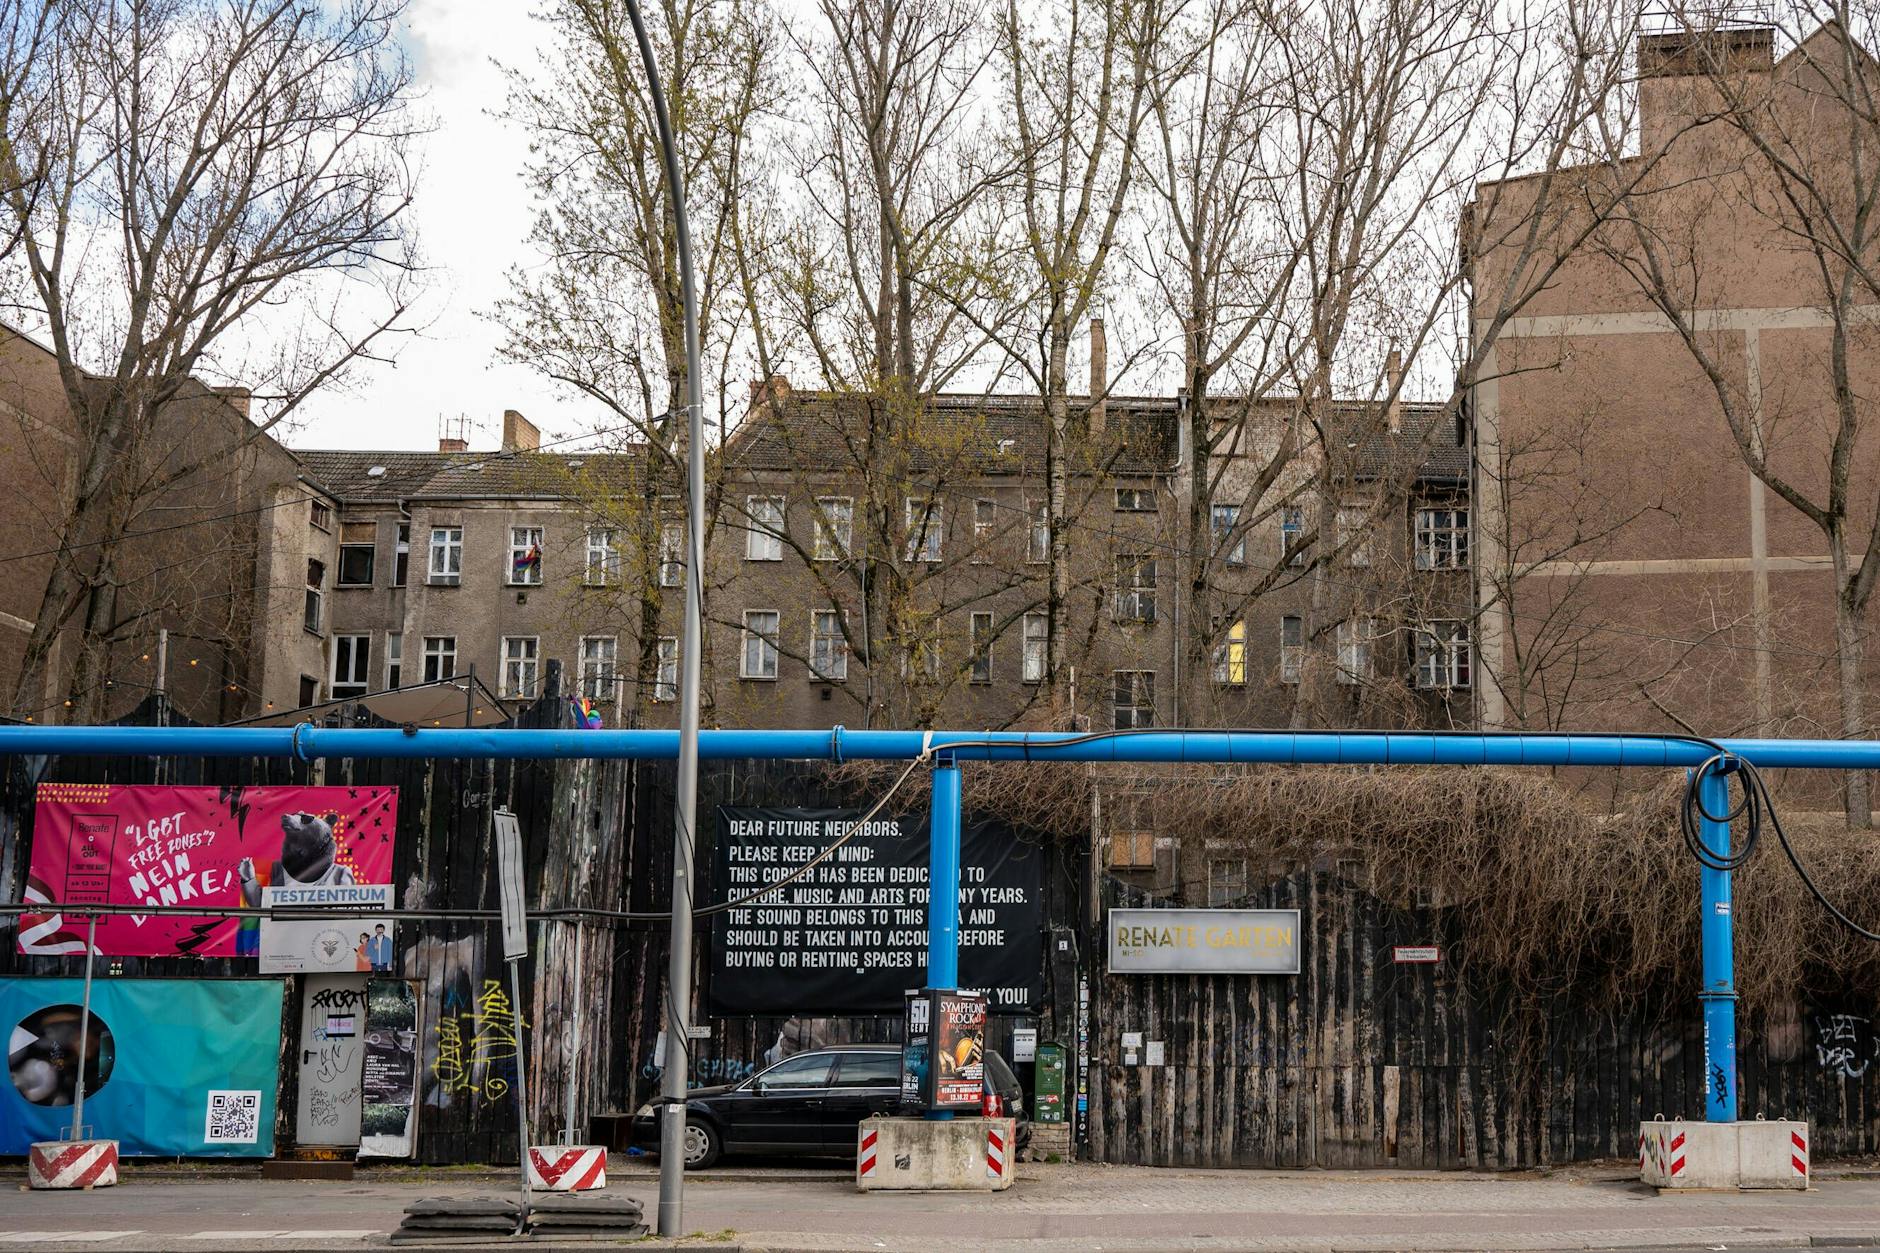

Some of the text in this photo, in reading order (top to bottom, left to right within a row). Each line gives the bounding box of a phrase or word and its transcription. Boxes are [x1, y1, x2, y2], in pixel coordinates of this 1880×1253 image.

[730, 820, 764, 837] DEAR
[768, 821, 820, 837] FUTURE
[128, 841, 165, 870] FREE
[729, 846, 875, 862] PLEASE KEEP IN MIND:
[129, 852, 191, 899] NEIN
[729, 867, 985, 883] THIS CORNER HAS BEEN DEDIC TO
[271, 888, 385, 902] TESTZENTRUM
[793, 888, 834, 904] MUSIC
[838, 888, 865, 904] AND
[870, 888, 904, 904] ARTS
[981, 888, 1028, 904] YEARS.
[727, 909, 752, 925] THE
[757, 909, 801, 925] SOUND
[806, 909, 866, 925] BELONGS
[871, 909, 889, 925] TO
[894, 909, 924, 925] THIS
[969, 909, 996, 925] AND
[726, 930, 1005, 946] SHOULD BE TAKEN INTO ACCOU BEFORE
[1117, 926, 1293, 949] RENATE GARTEN
[725, 951, 775, 967] BUYING
[779, 951, 797, 967] OR
[802, 951, 858, 967] RENTING
[863, 951, 912, 967] SPACES
[996, 988, 1028, 1005] YOU!
[911, 1000, 930, 1023] 50
[949, 1013, 975, 1024] ROCK
[910, 1023, 930, 1033] CENT
